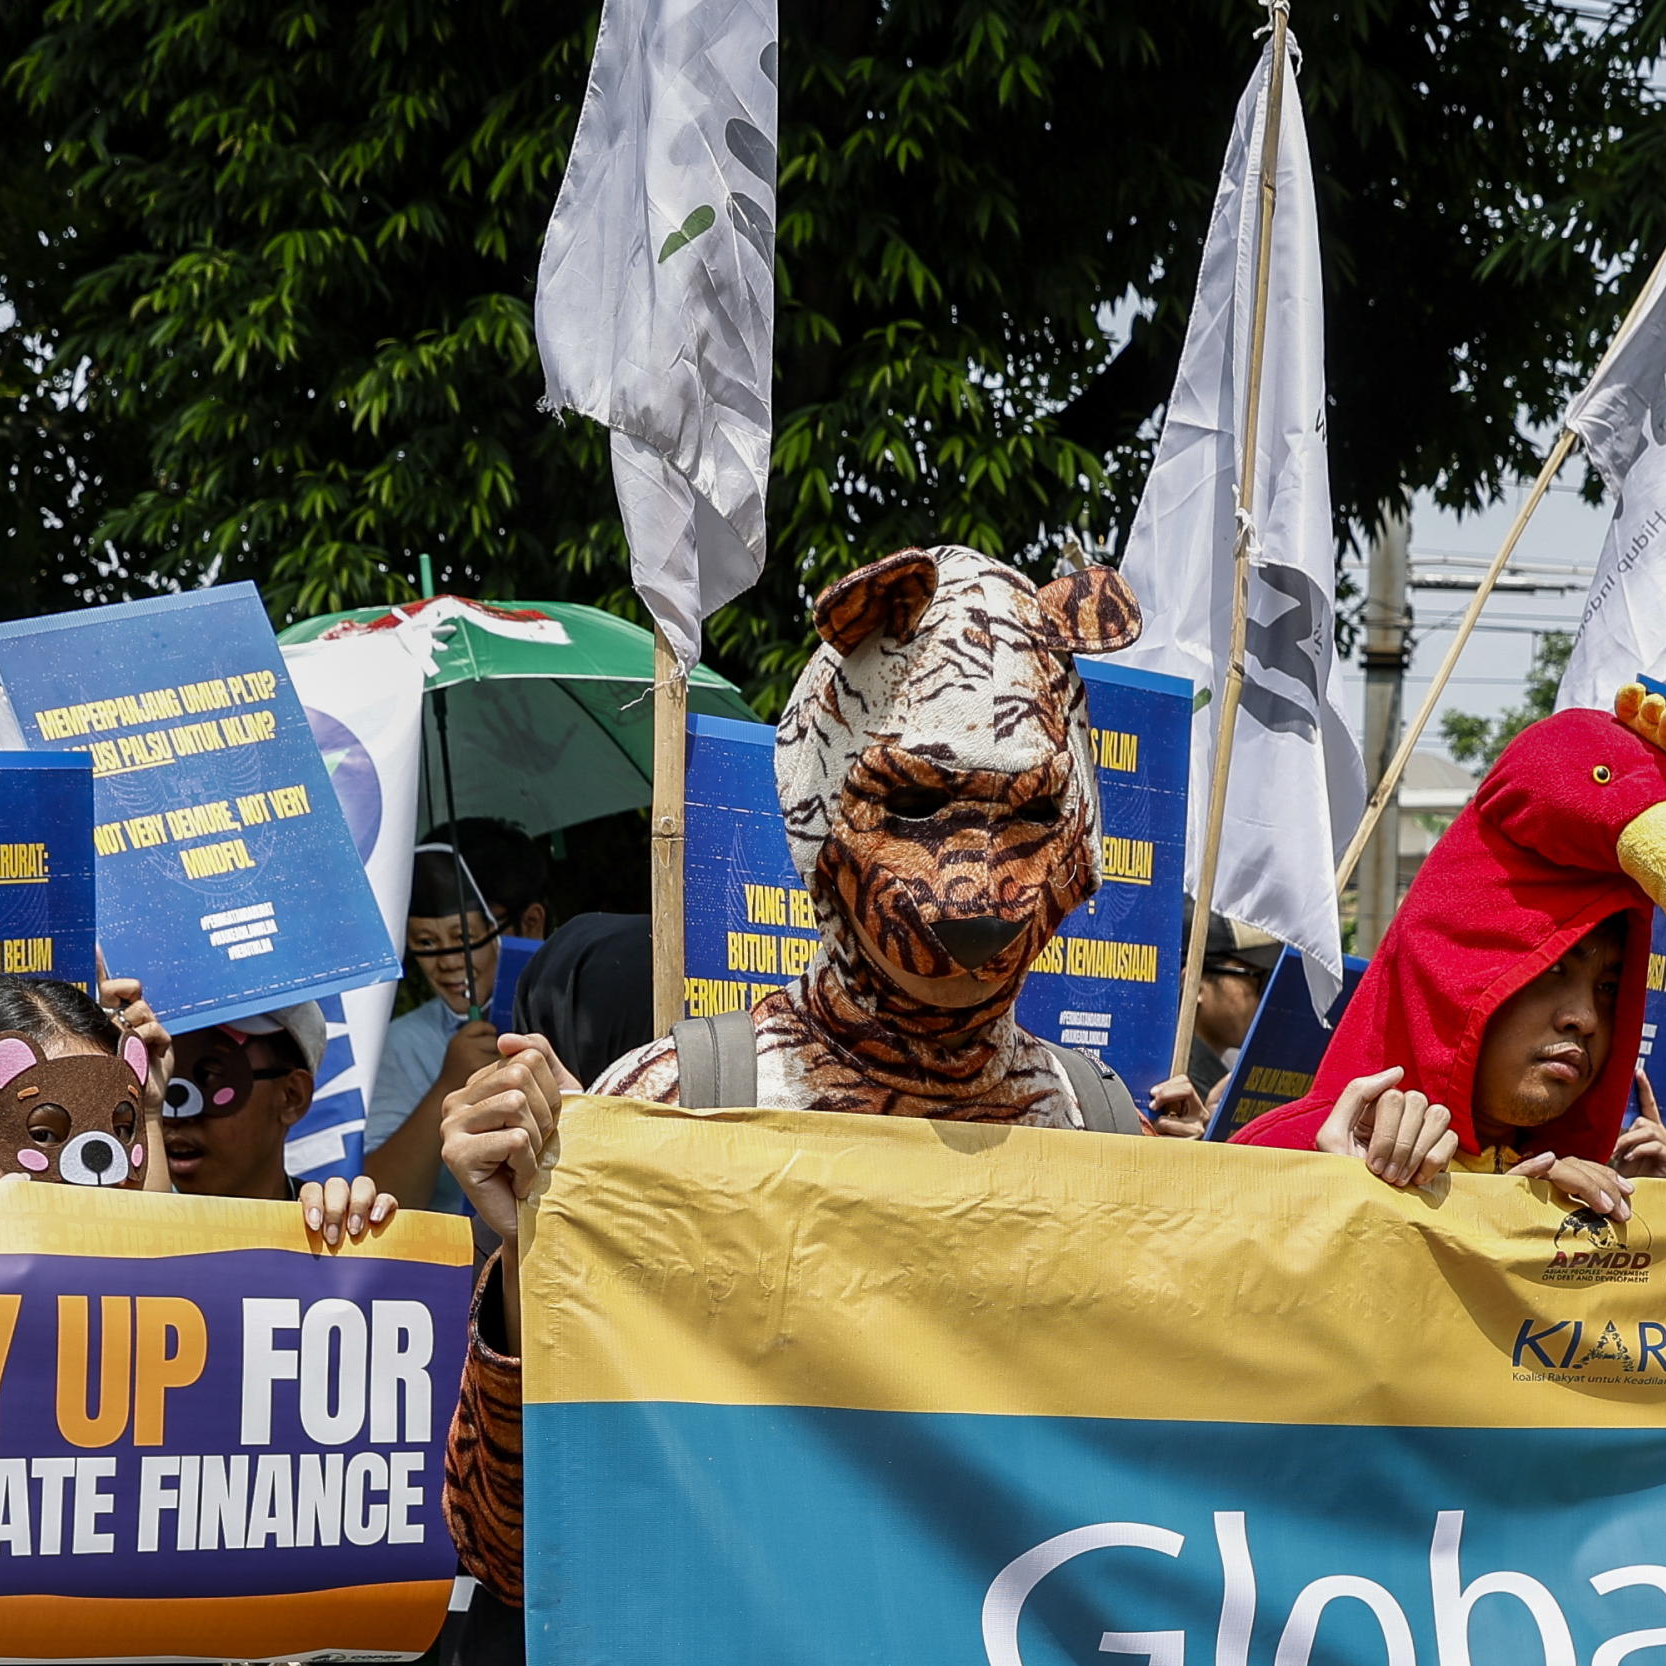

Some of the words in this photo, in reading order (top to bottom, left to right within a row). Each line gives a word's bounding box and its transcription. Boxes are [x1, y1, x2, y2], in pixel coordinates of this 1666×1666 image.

[35, 687, 182, 742] MEMPERPANJANG
[177, 679, 233, 715] UMUR
[227, 669, 277, 706] PLTU?
[121, 729, 176, 771] PALSU
[168, 719, 226, 758] UNTUK
[219, 709, 277, 748] IKLIM?
[1099, 729, 1139, 773] IKLIM
[94, 821, 128, 857] NOT
[123, 813, 169, 850] VERY
[165, 799, 244, 842] DEMURE,
[235, 792, 273, 828] NOT
[267, 784, 312, 821] VERY
[744, 883, 787, 927] YANG
[3, 937, 53, 974] BELUM
[727, 931, 778, 975] BUTUH
[1065, 936, 1158, 984] KEMANUSIAAN
[1546, 1250, 1652, 1270] APMDD
[55, 1294, 210, 1449] UP
[240, 1296, 436, 1447] FOR
[1512, 1372, 1546, 1382] Koalisi
[1547, 1373, 1586, 1384] Rakyat
[1587, 1375, 1622, 1385] untuk
[136, 1450, 425, 1553] FINANCE
